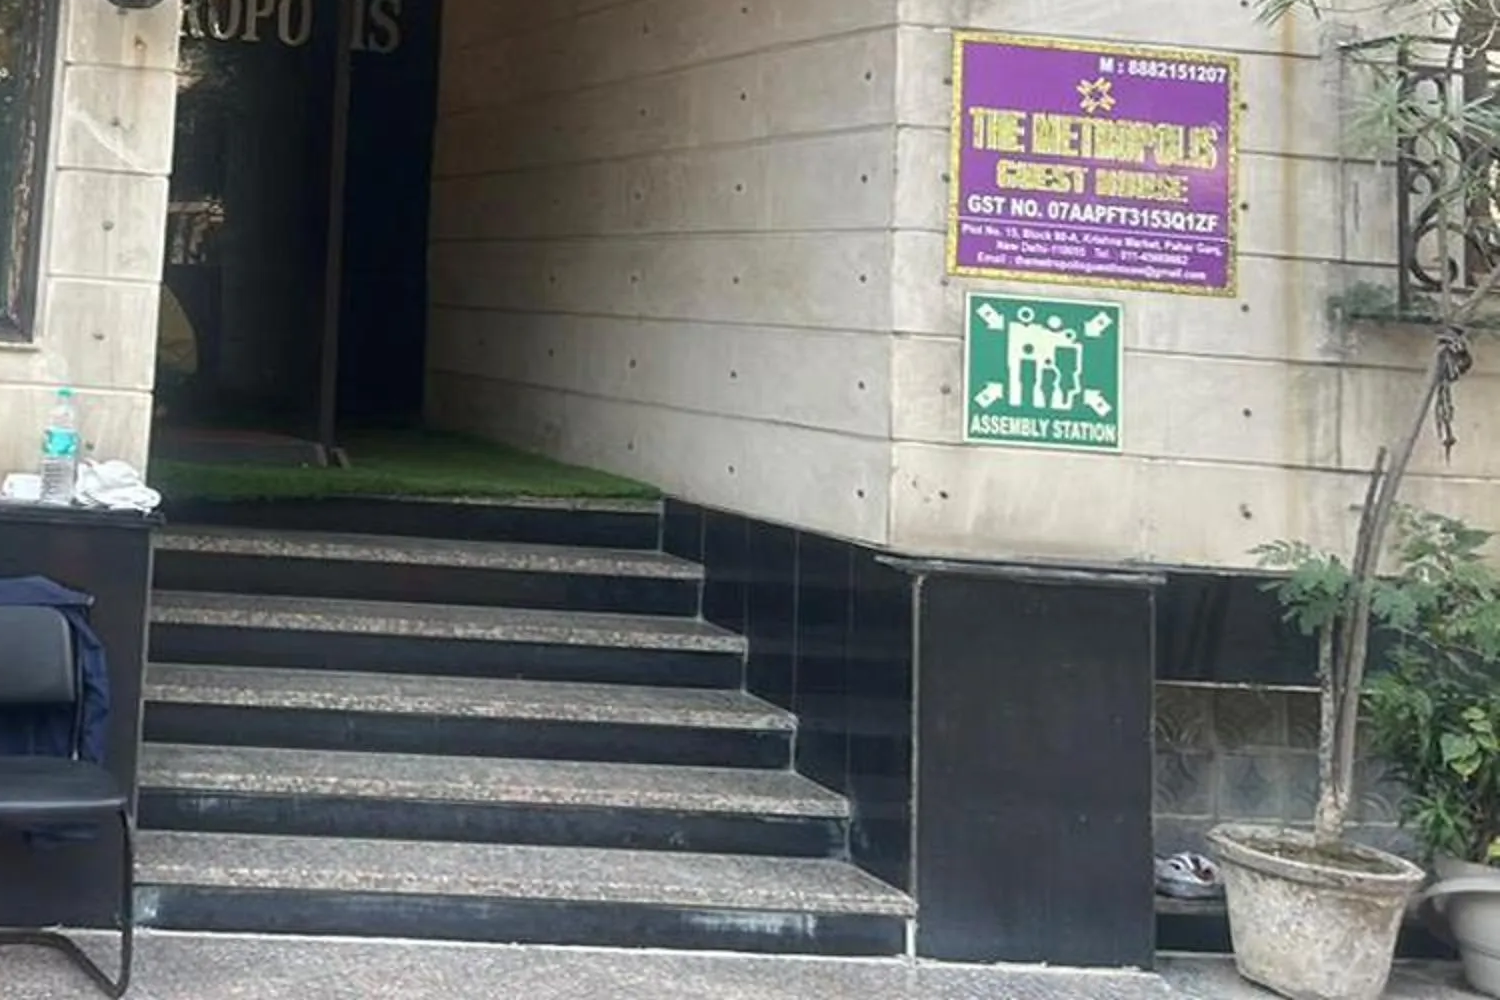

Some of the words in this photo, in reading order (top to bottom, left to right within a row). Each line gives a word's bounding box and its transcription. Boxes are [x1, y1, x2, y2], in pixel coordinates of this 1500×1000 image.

[1127, 59, 1228, 83] 8882151207
[969, 107, 1027, 153] THE
[1031, 112, 1219, 170] METROPOLIS
[996, 159, 1089, 194] GUEST
[967, 194, 1006, 214] GST
[1010, 198, 1043, 217] NO.
[970, 414, 1050, 439] ASSEMBLY
[1052, 419, 1117, 442] STATION
